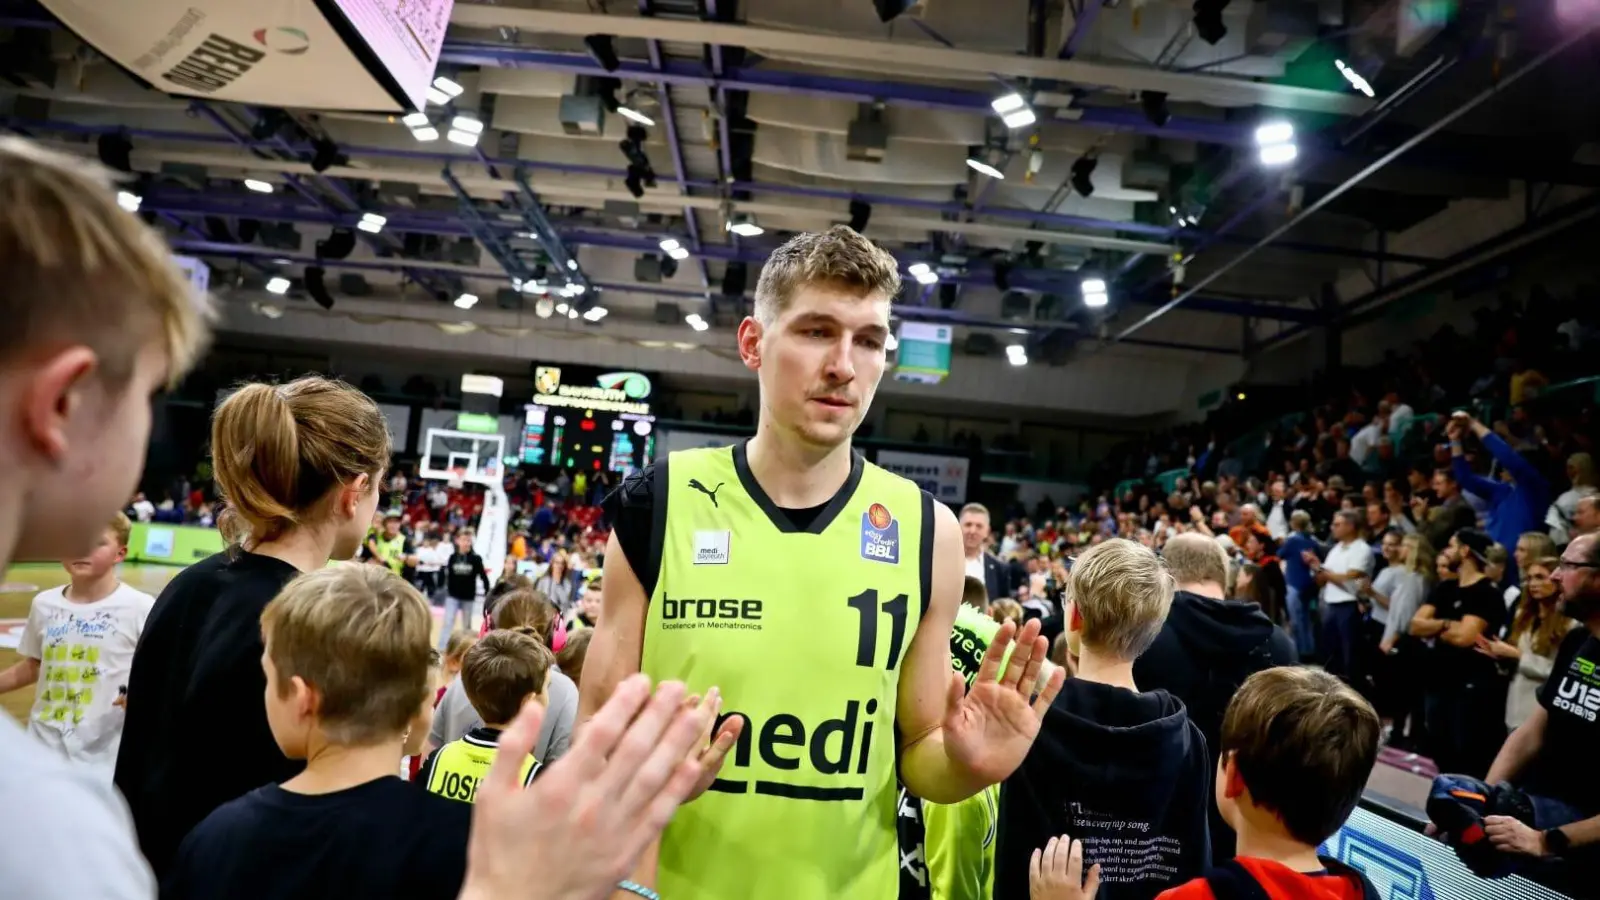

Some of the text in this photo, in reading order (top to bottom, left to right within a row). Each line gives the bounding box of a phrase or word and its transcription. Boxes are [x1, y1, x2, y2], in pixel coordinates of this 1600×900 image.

[864, 542, 895, 560] BBL
[662, 591, 763, 619] brose
[707, 622, 762, 630] Mechatronics
[847, 588, 909, 671] 11
[1558, 676, 1600, 711] U12
[1112, 820, 1126, 830] rap
[1127, 821, 1150, 832] song.
